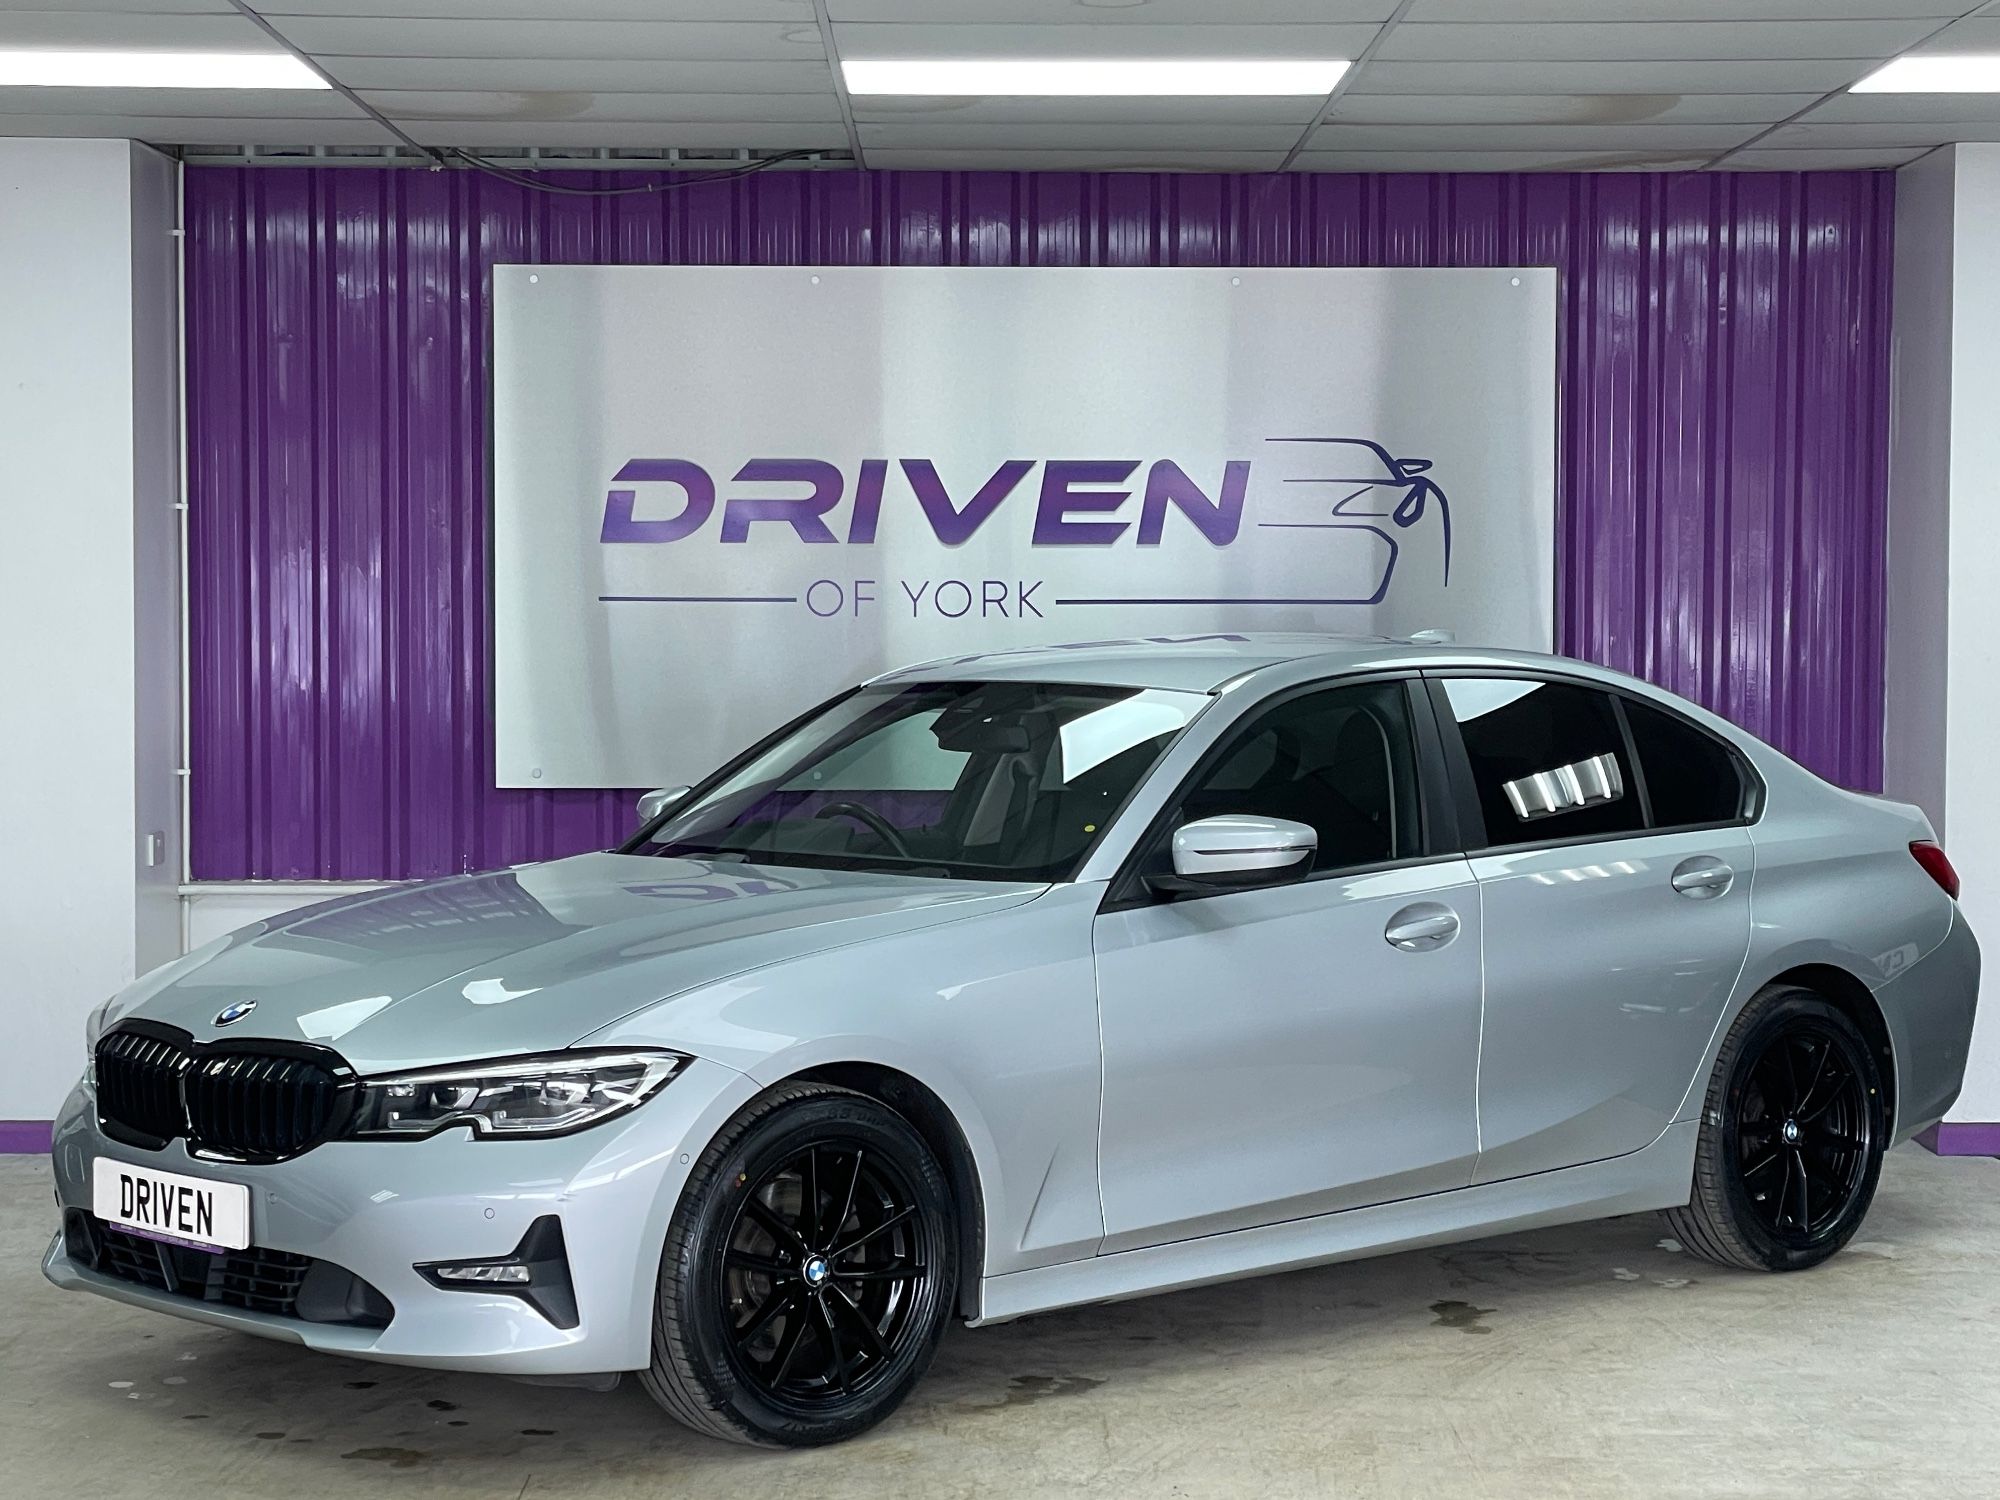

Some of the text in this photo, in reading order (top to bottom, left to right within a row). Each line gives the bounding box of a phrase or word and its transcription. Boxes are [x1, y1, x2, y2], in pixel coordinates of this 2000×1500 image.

[599, 457, 1252, 547] DRIVEN
[806, 579, 1045, 619] OF YORK
[120, 1173, 213, 1237] DRIVEN
